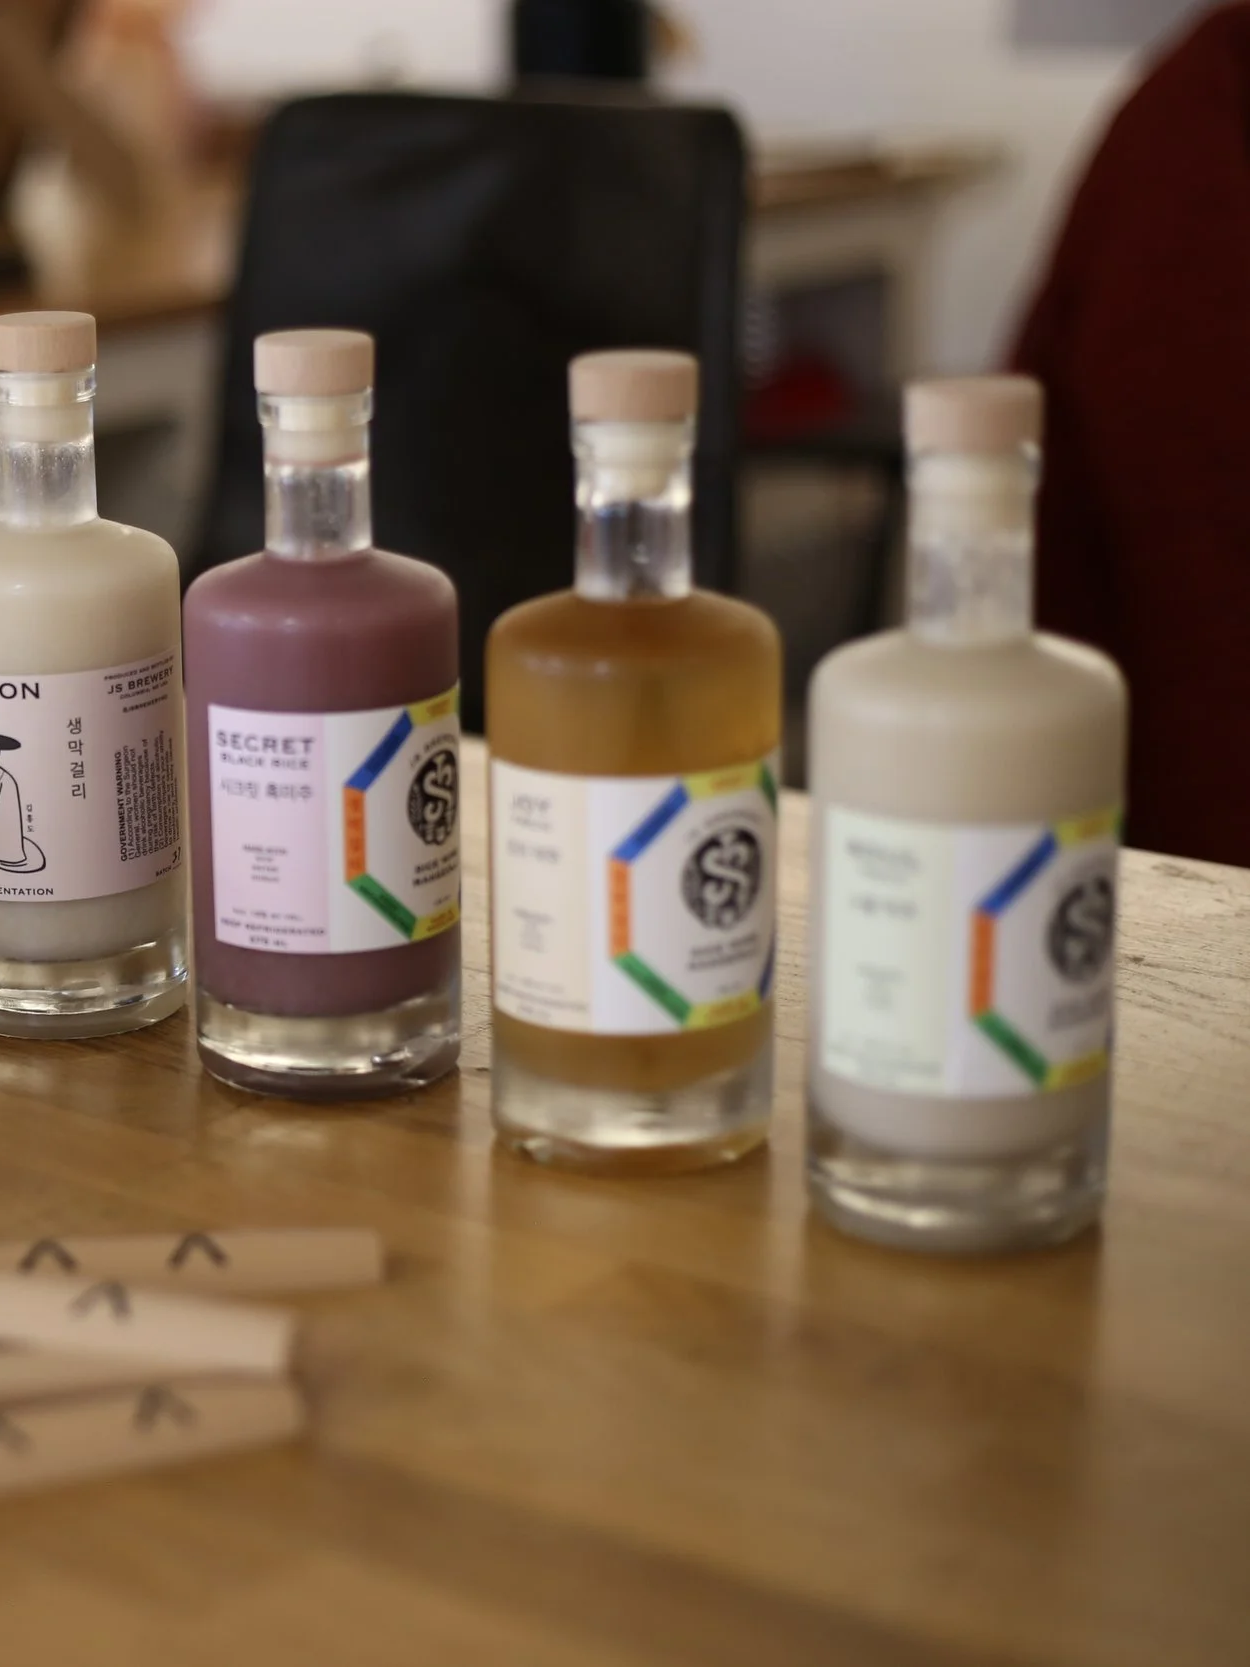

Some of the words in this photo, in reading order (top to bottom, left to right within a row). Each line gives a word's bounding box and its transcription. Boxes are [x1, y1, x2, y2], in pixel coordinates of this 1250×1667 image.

[108, 683, 123, 695] JS
[128, 665, 174, 691] BREWERY
[67, 717, 86, 799] 생막걸리
[216, 730, 316, 755] SECRET
[114, 751, 124, 795] WARNING
[220, 752, 264, 768] BLACK
[271, 758, 310, 771] RICE
[117, 798, 127, 862] GOVERNMENT
